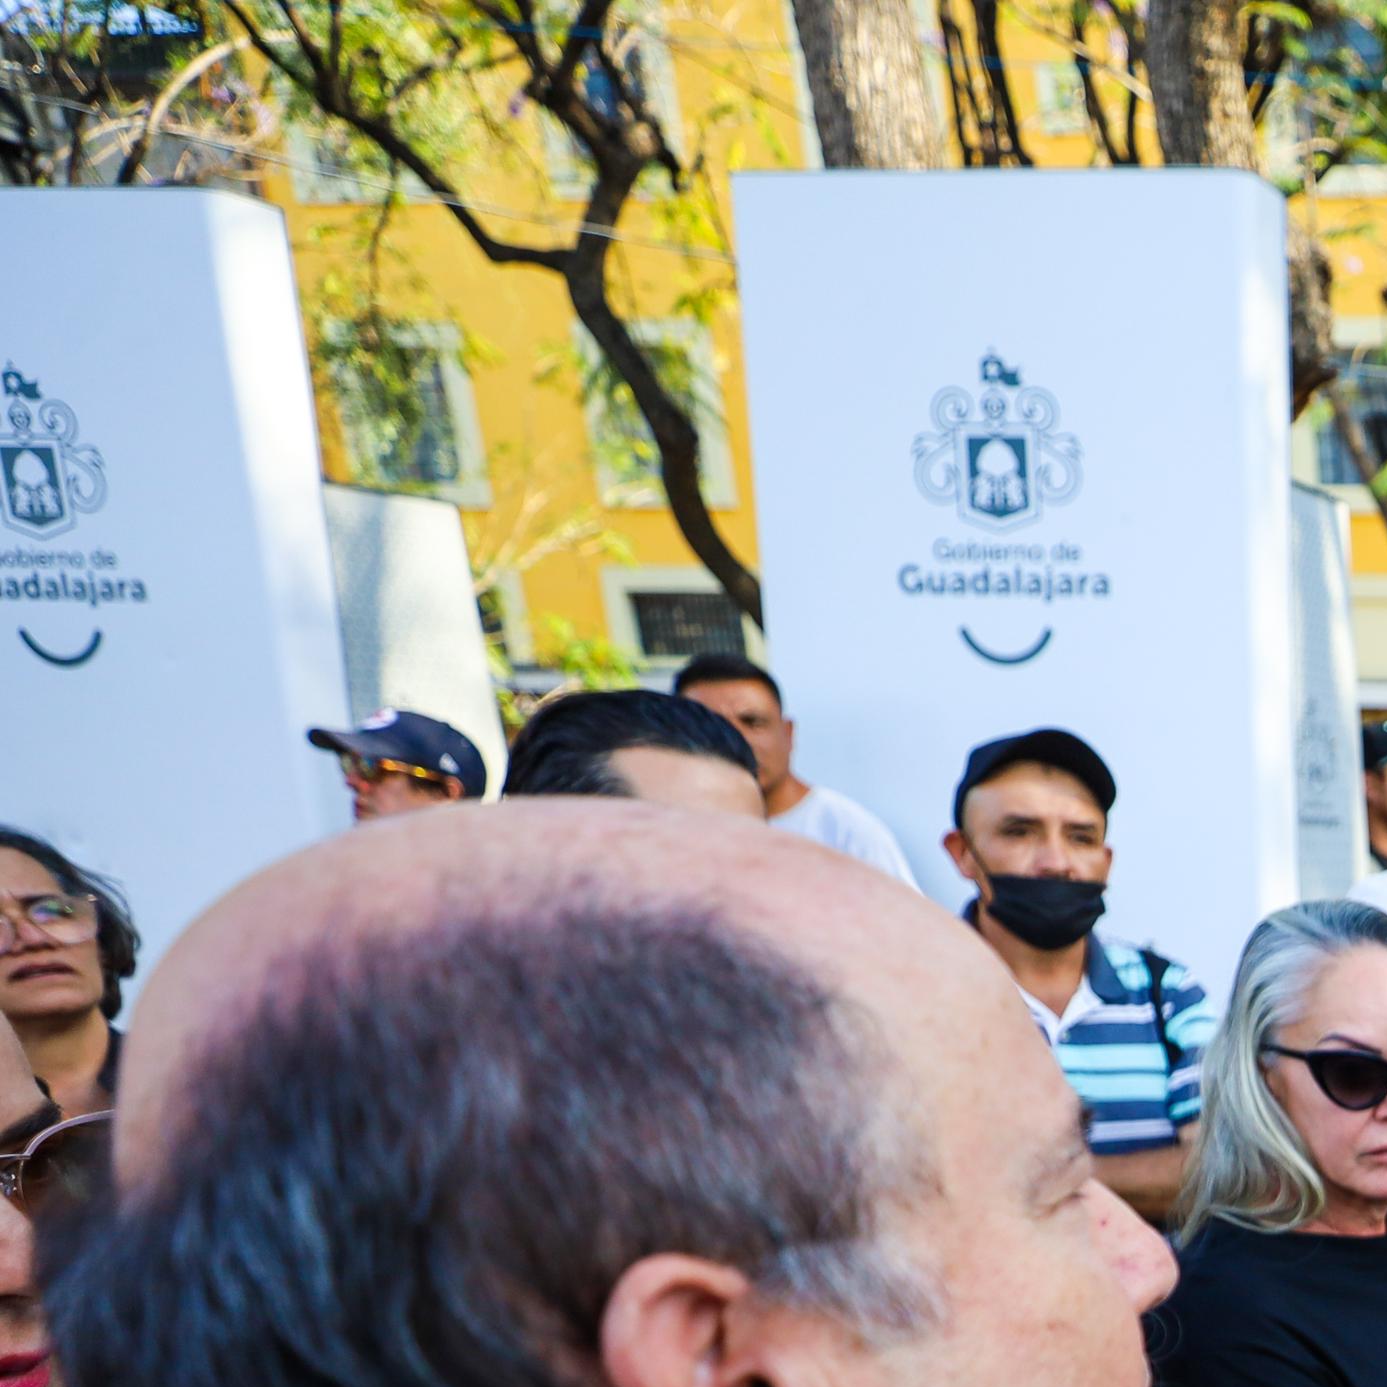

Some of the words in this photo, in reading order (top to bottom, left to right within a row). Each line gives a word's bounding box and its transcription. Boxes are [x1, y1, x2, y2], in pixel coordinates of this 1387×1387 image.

[0, 546, 85, 568] obierno
[89, 546, 118, 569] de
[932, 537, 1045, 561] Gobierno
[1051, 541, 1083, 561] de
[0, 570, 148, 608] adalajara
[898, 563, 1110, 603] Guadalajara
